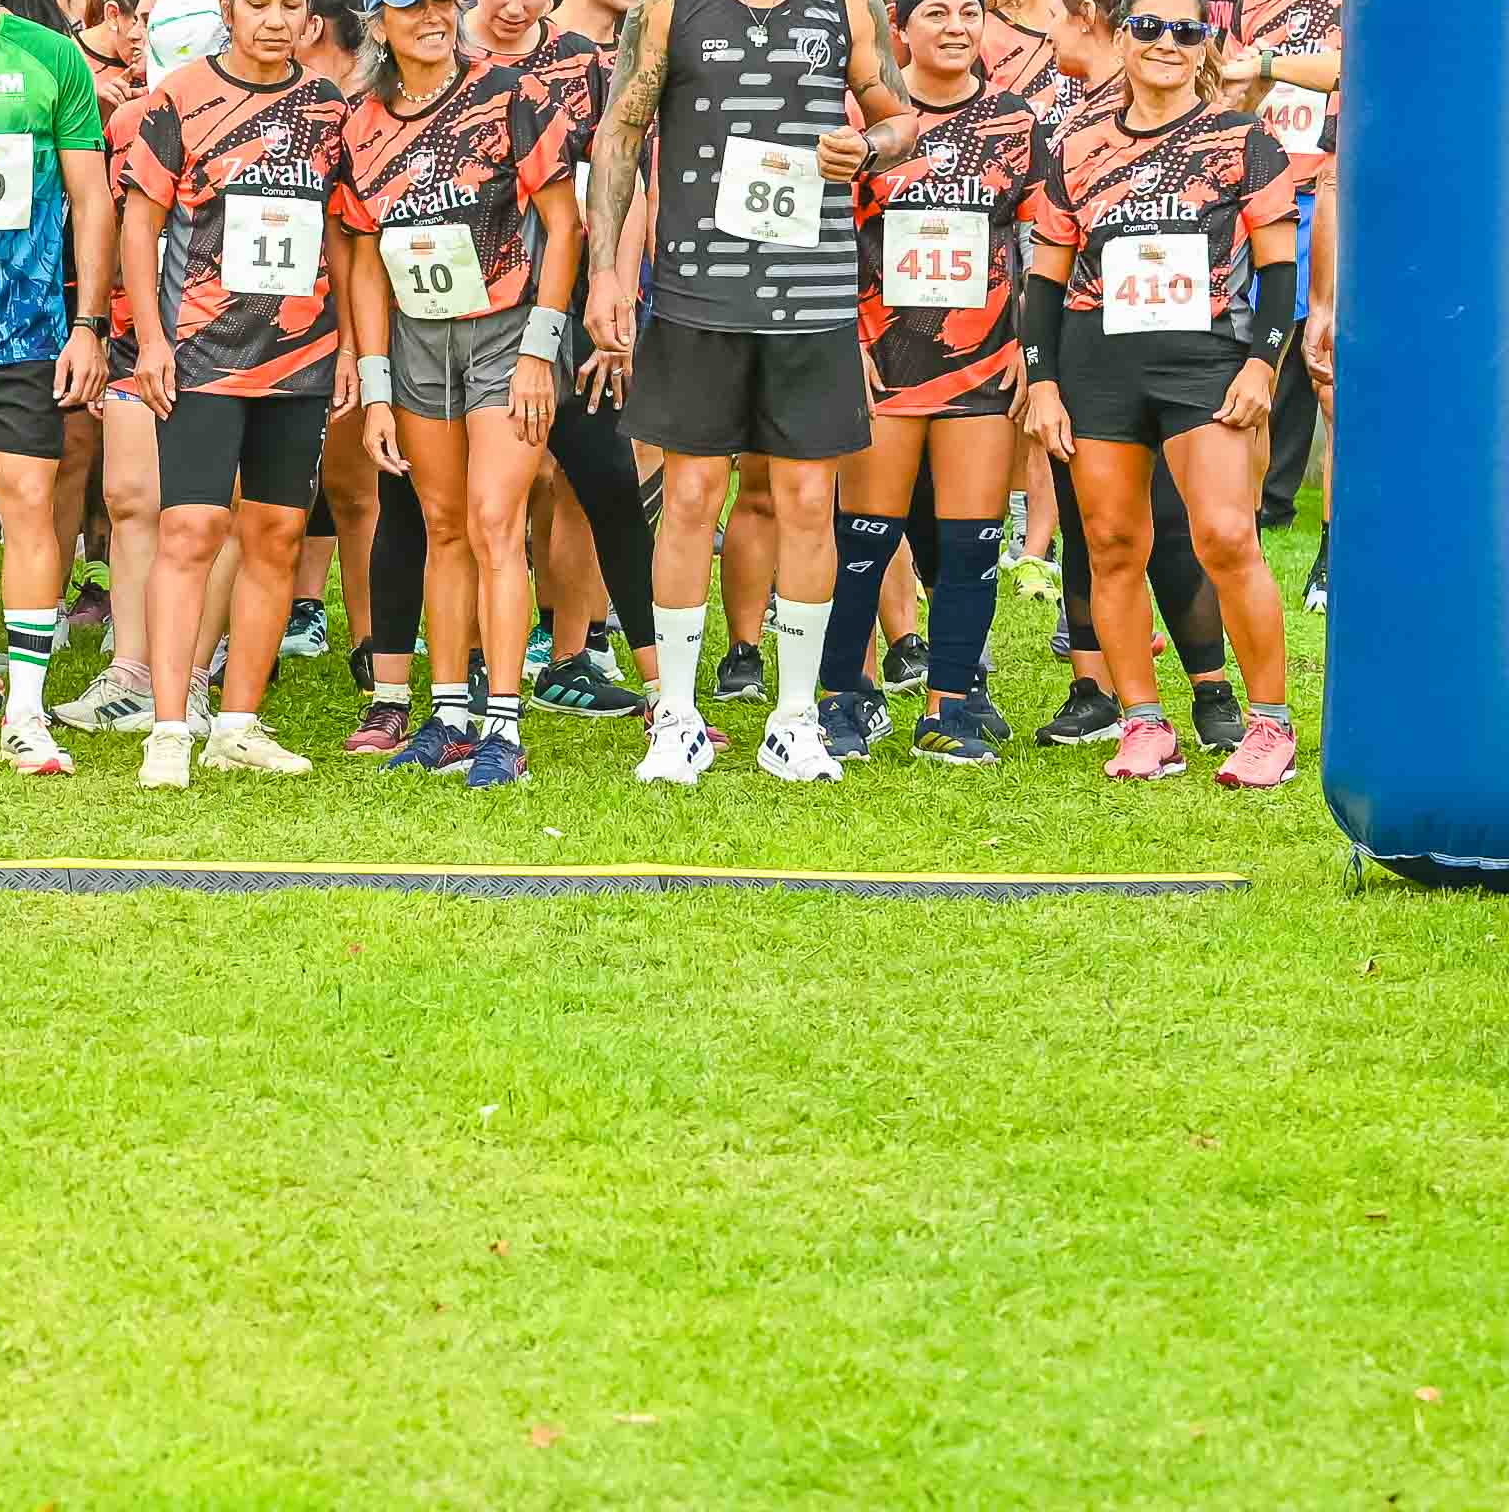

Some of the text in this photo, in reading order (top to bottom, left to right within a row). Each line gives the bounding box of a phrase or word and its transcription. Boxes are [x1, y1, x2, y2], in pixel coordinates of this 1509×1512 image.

[221, 157, 324, 191] Zavalla
[885, 174, 995, 207] Zavalla
[261, 186, 296, 197] Comuna
[377, 179, 480, 224] Zavalla
[744, 180, 796, 218] 86
[1090, 192, 1199, 229] Zavalla
[1122, 223, 1159, 234] Comuna
[252, 236, 296, 269] 11
[896, 249, 972, 281] 415
[408, 263, 454, 294] 10
[1115, 273, 1193, 306] 410
